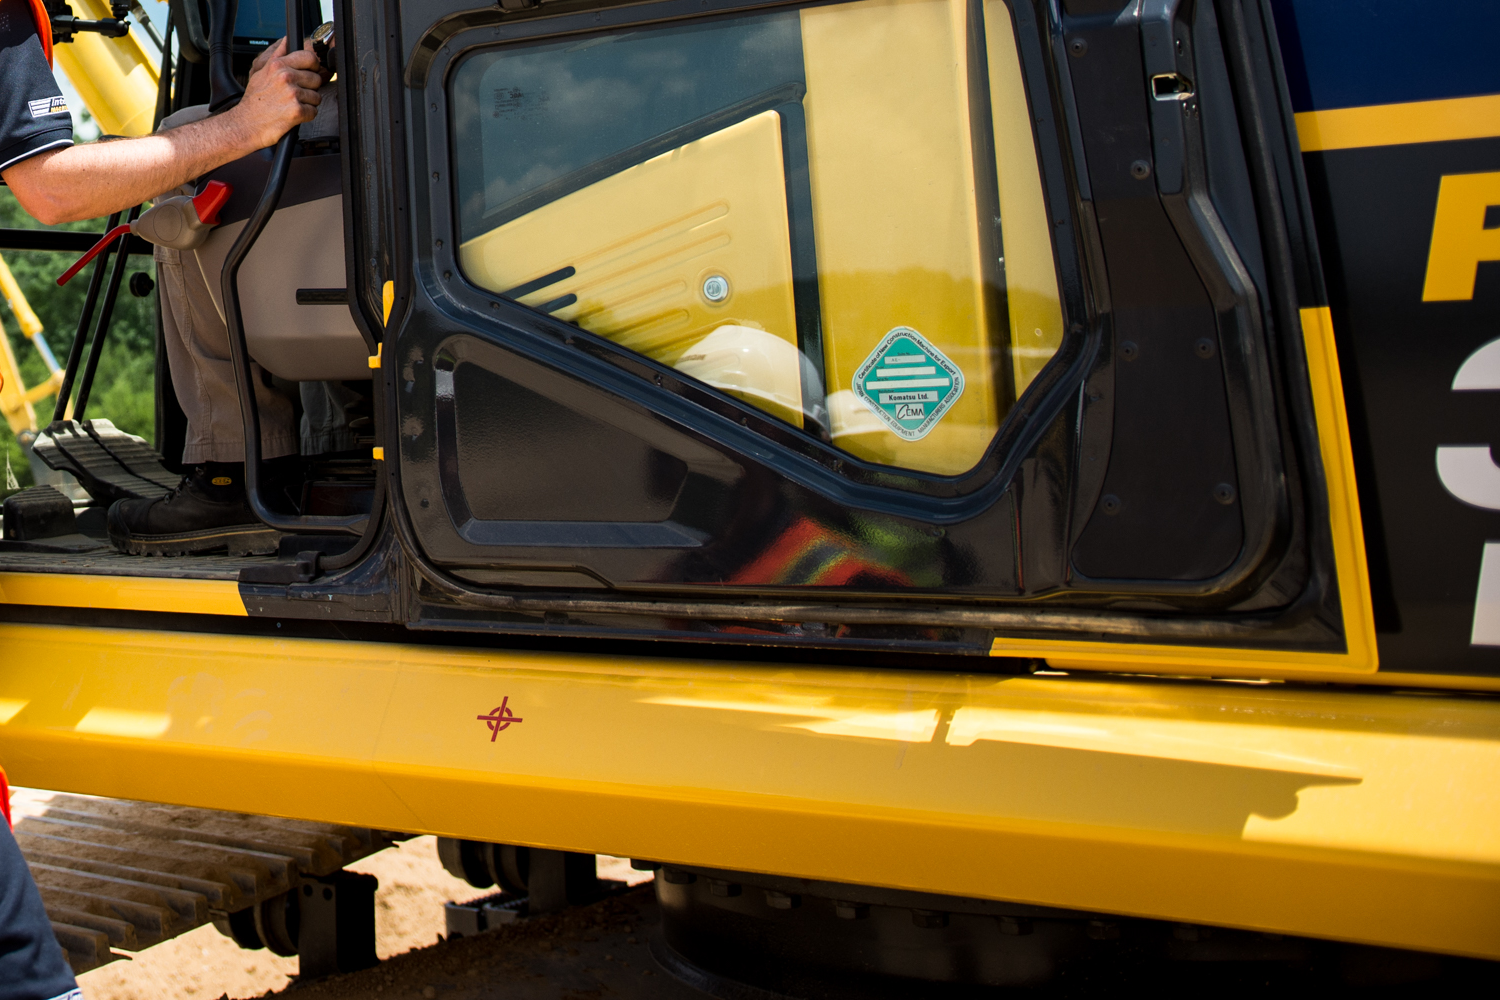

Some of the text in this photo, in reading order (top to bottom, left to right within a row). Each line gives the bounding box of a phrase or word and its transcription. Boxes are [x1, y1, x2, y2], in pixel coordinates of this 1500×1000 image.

[858, 357, 877, 380] Certificate
[879, 344, 888, 354] New
[887, 332, 917, 345] Construction
[916, 339, 935, 356] Machine
[940, 360, 956, 376] Export
[856, 376, 960, 437] JAPAN CONSTRUCTION EQUIPMENT MANUFACTURERS ASSOCIATION
[896, 404, 924, 420] CEMA
